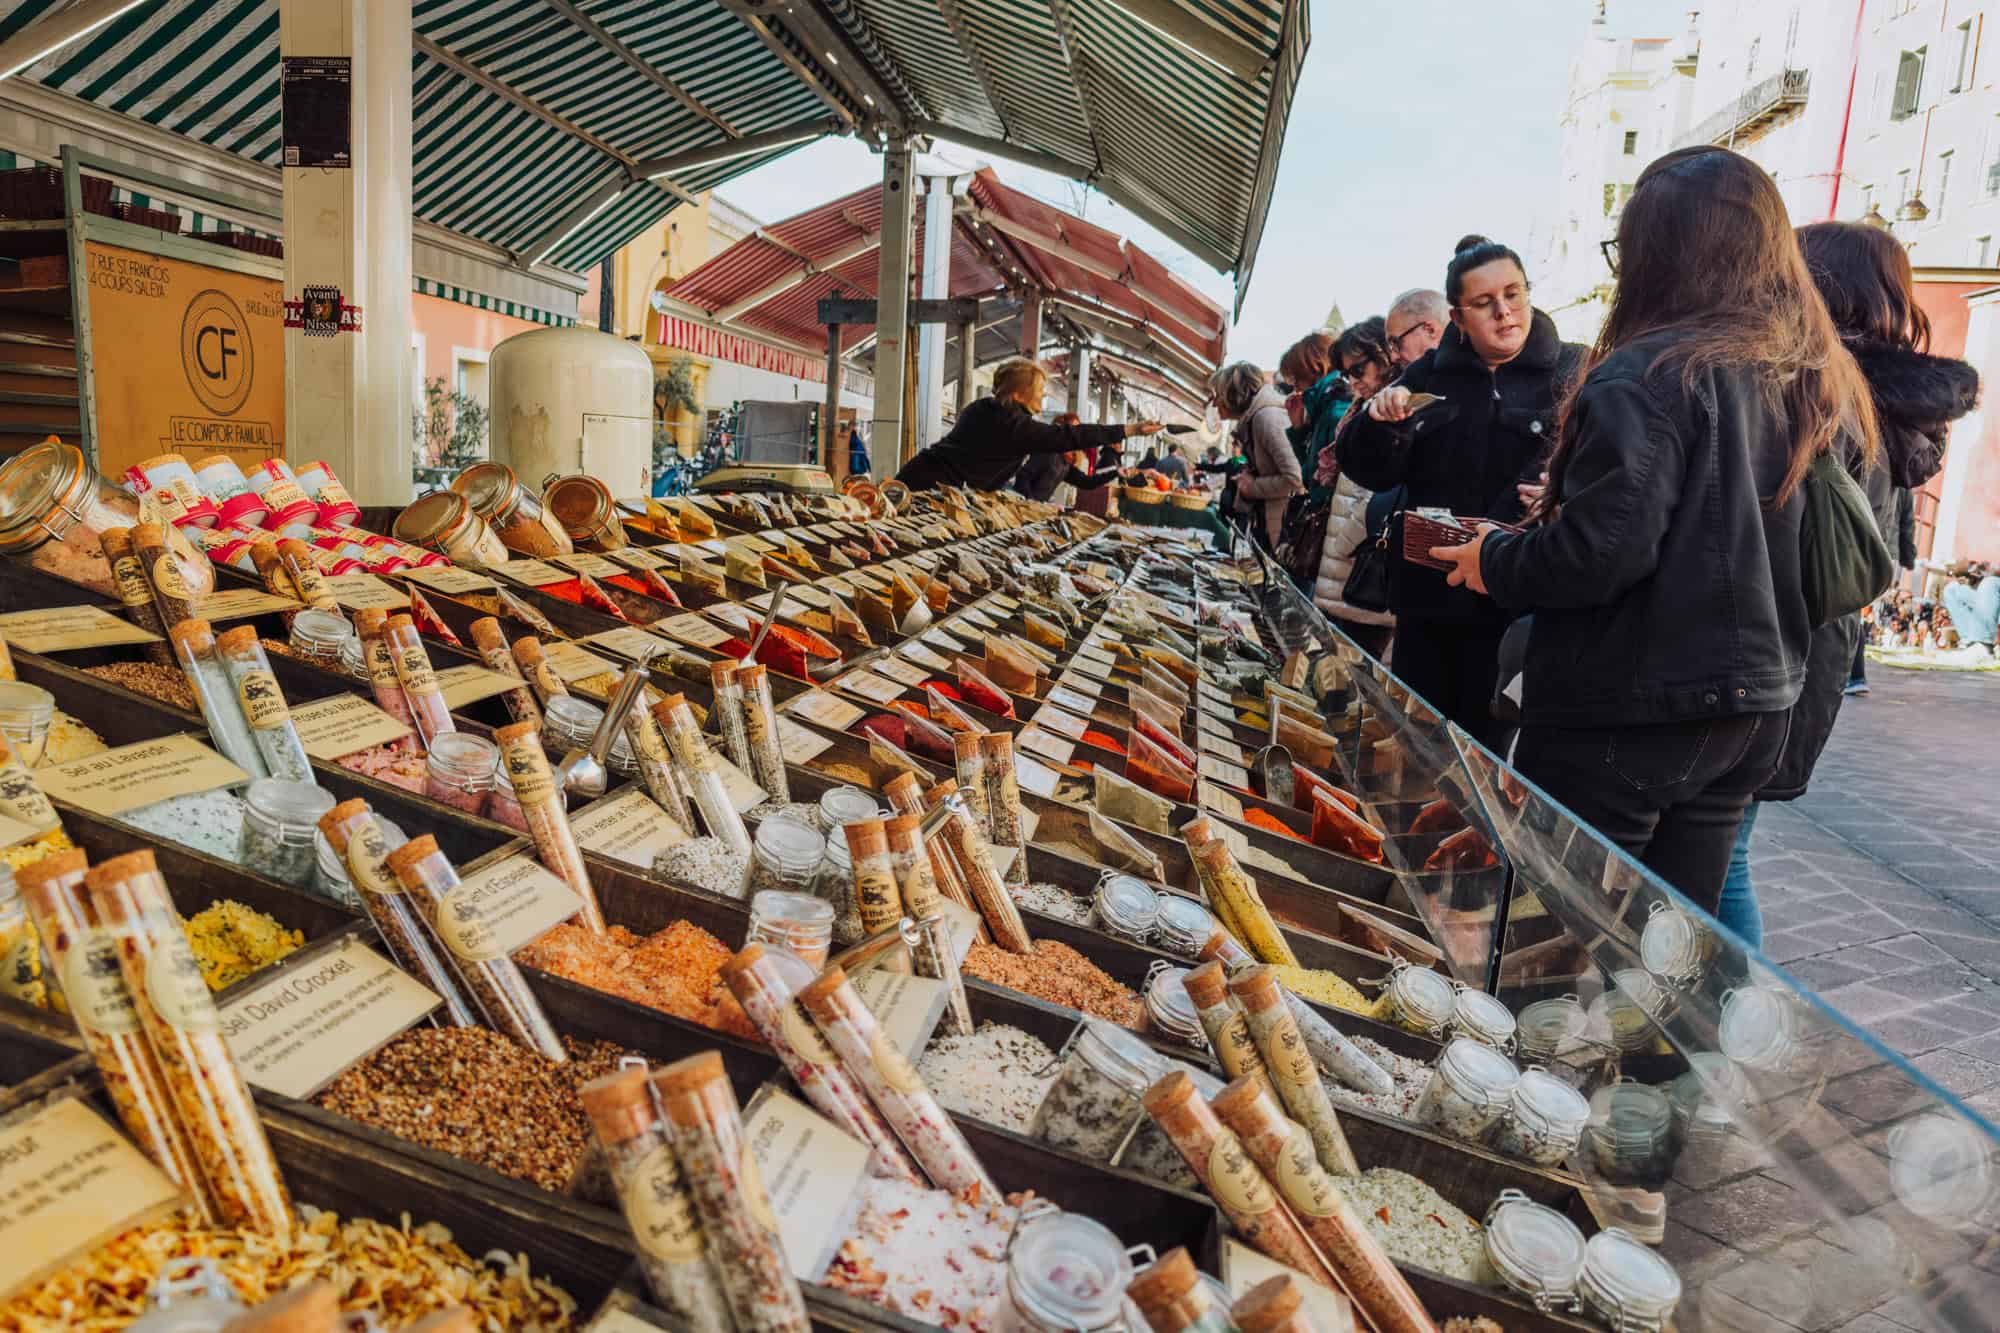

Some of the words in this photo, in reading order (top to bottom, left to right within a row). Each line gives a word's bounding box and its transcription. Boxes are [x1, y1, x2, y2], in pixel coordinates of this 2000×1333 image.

[98, 254, 115, 273] RUE
[89, 272, 98, 287] 4
[99, 272, 132, 294] COURS
[304, 289, 338, 300] Avanti
[305, 319, 337, 330] Nissa
[196, 326, 237, 380] CF
[173, 421, 185, 441] LE
[252, 703, 267, 713] Sel
[59, 765, 90, 777] Sel
[90, 757, 113, 771] au
[223, 1012, 249, 1038] Sel
[244, 987, 299, 1022] David
[292, 959, 355, 995] Crocket
